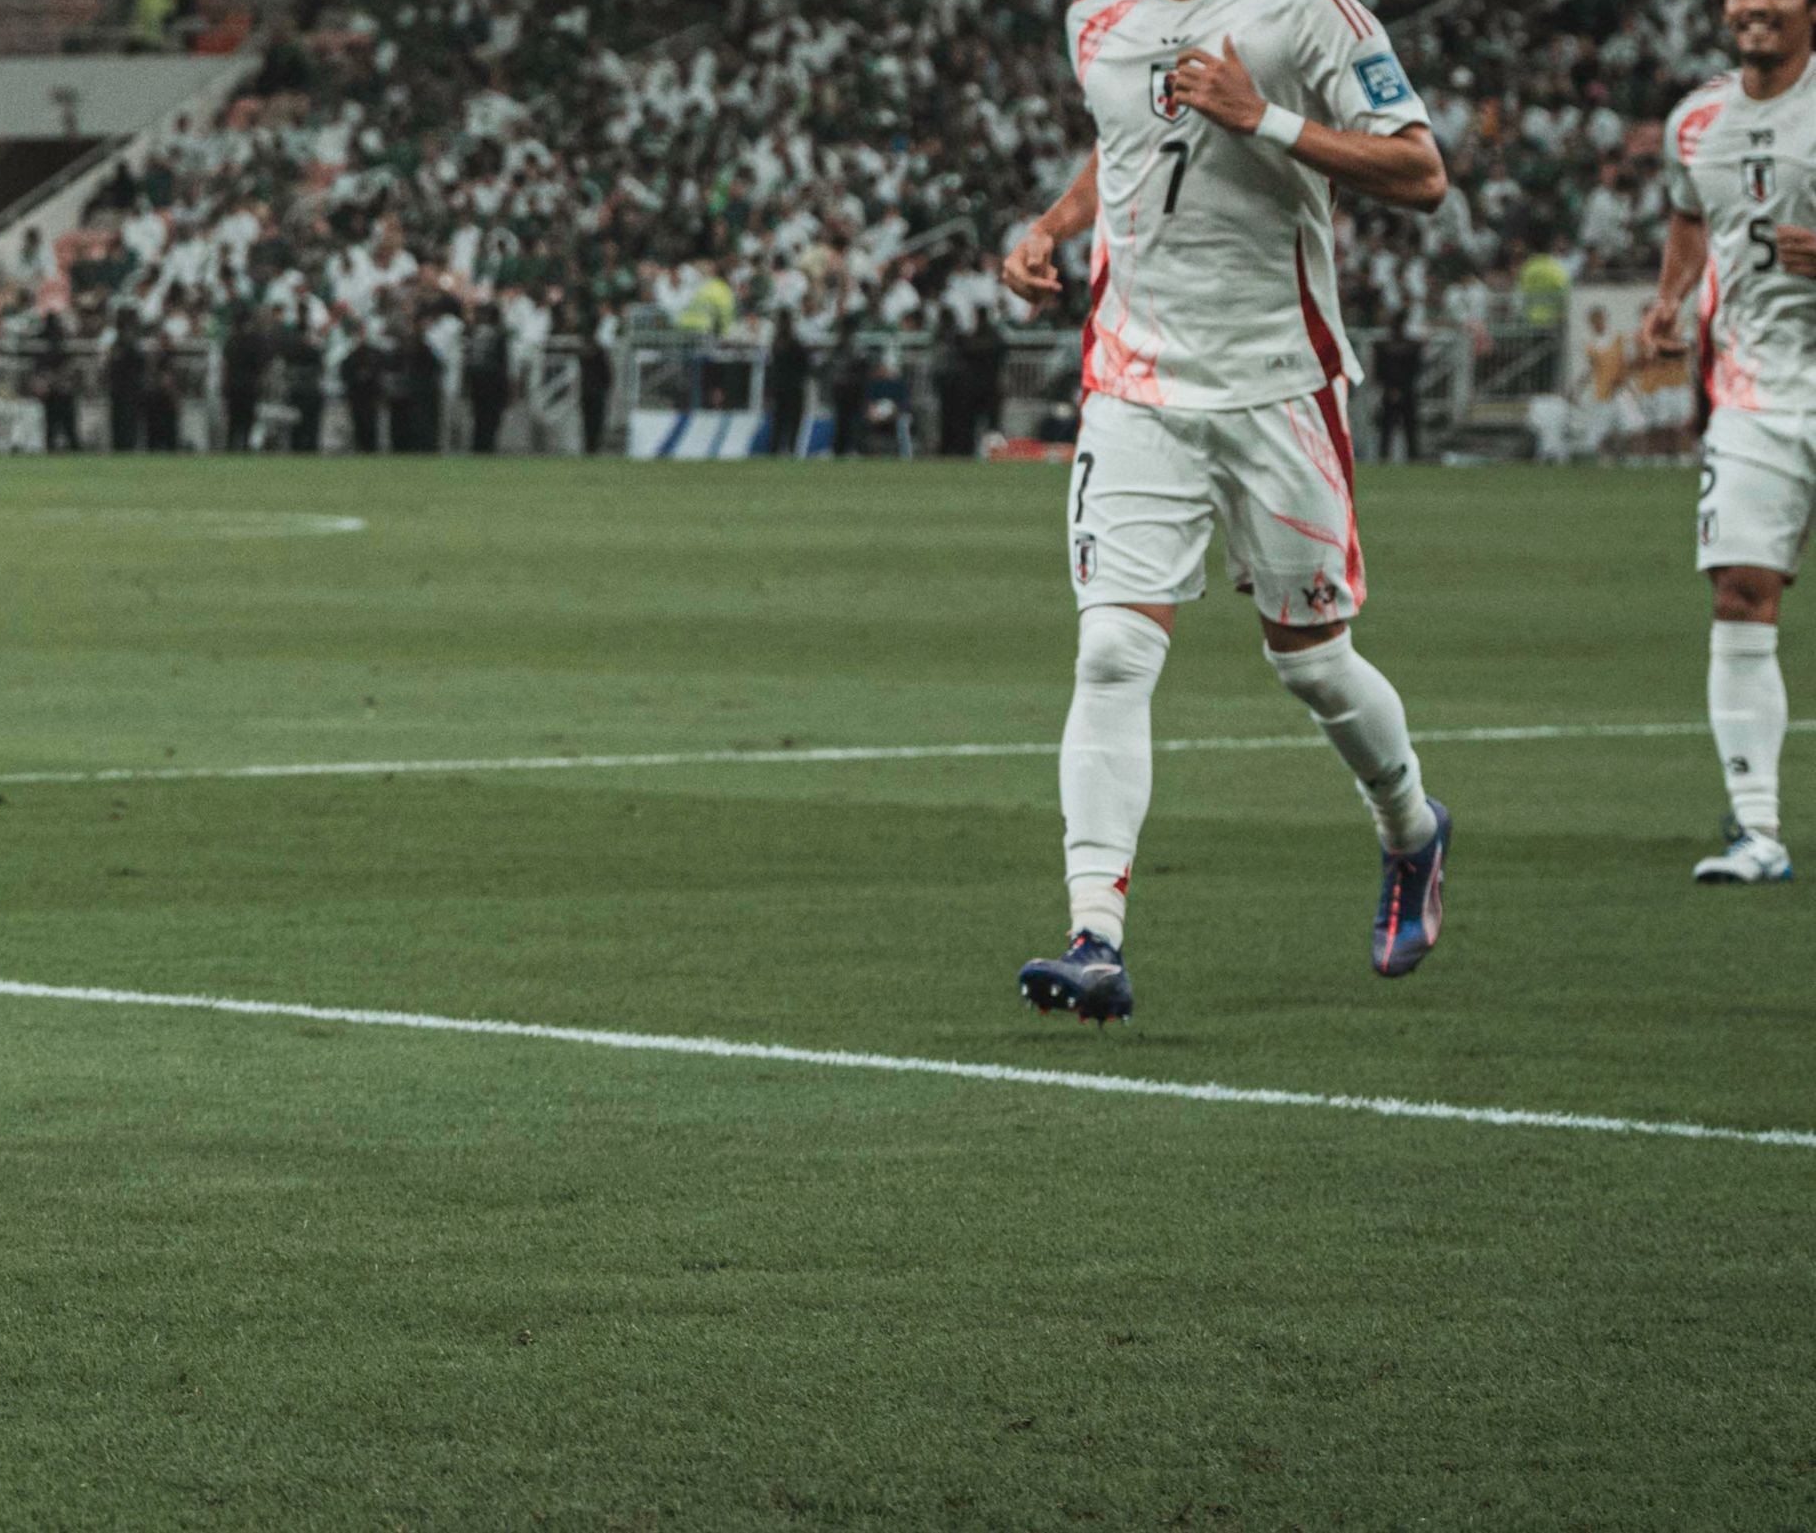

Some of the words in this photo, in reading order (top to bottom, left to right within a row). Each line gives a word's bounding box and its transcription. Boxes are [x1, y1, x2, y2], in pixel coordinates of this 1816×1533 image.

[1159, 140, 1189, 215] 7
[1748, 215, 1778, 273] 5
[1074, 451, 1096, 524] 7
